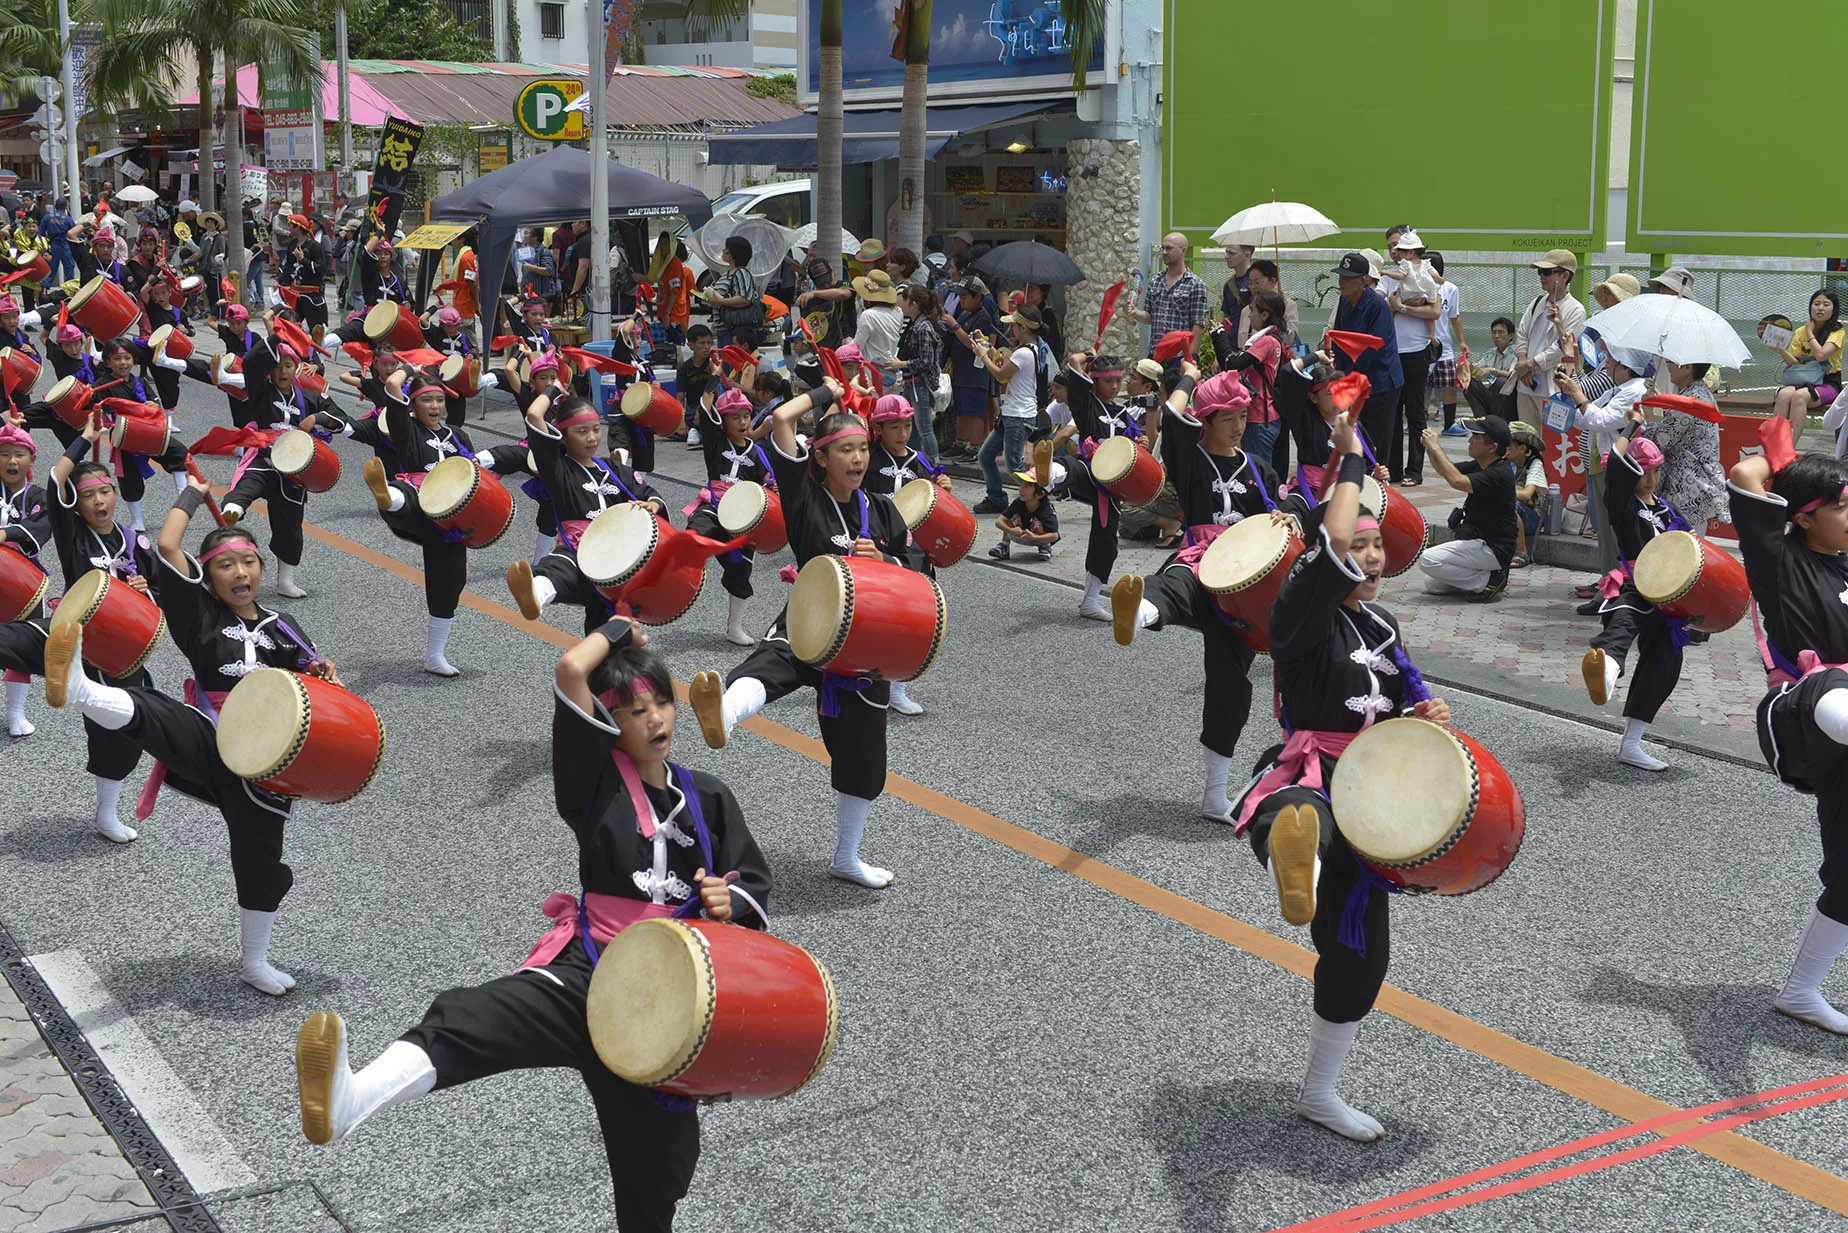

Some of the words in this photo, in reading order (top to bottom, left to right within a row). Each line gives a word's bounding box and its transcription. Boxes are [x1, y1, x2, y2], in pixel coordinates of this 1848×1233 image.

[536, 92, 562, 129] P
[628, 207, 660, 216] CAPTAIN
[660, 206, 679, 215] STAG
[1512, 238, 1556, 248] KOKUEIKAN
[1558, 238, 1593, 248] PROJECT
[1551, 432, 1587, 478] お
